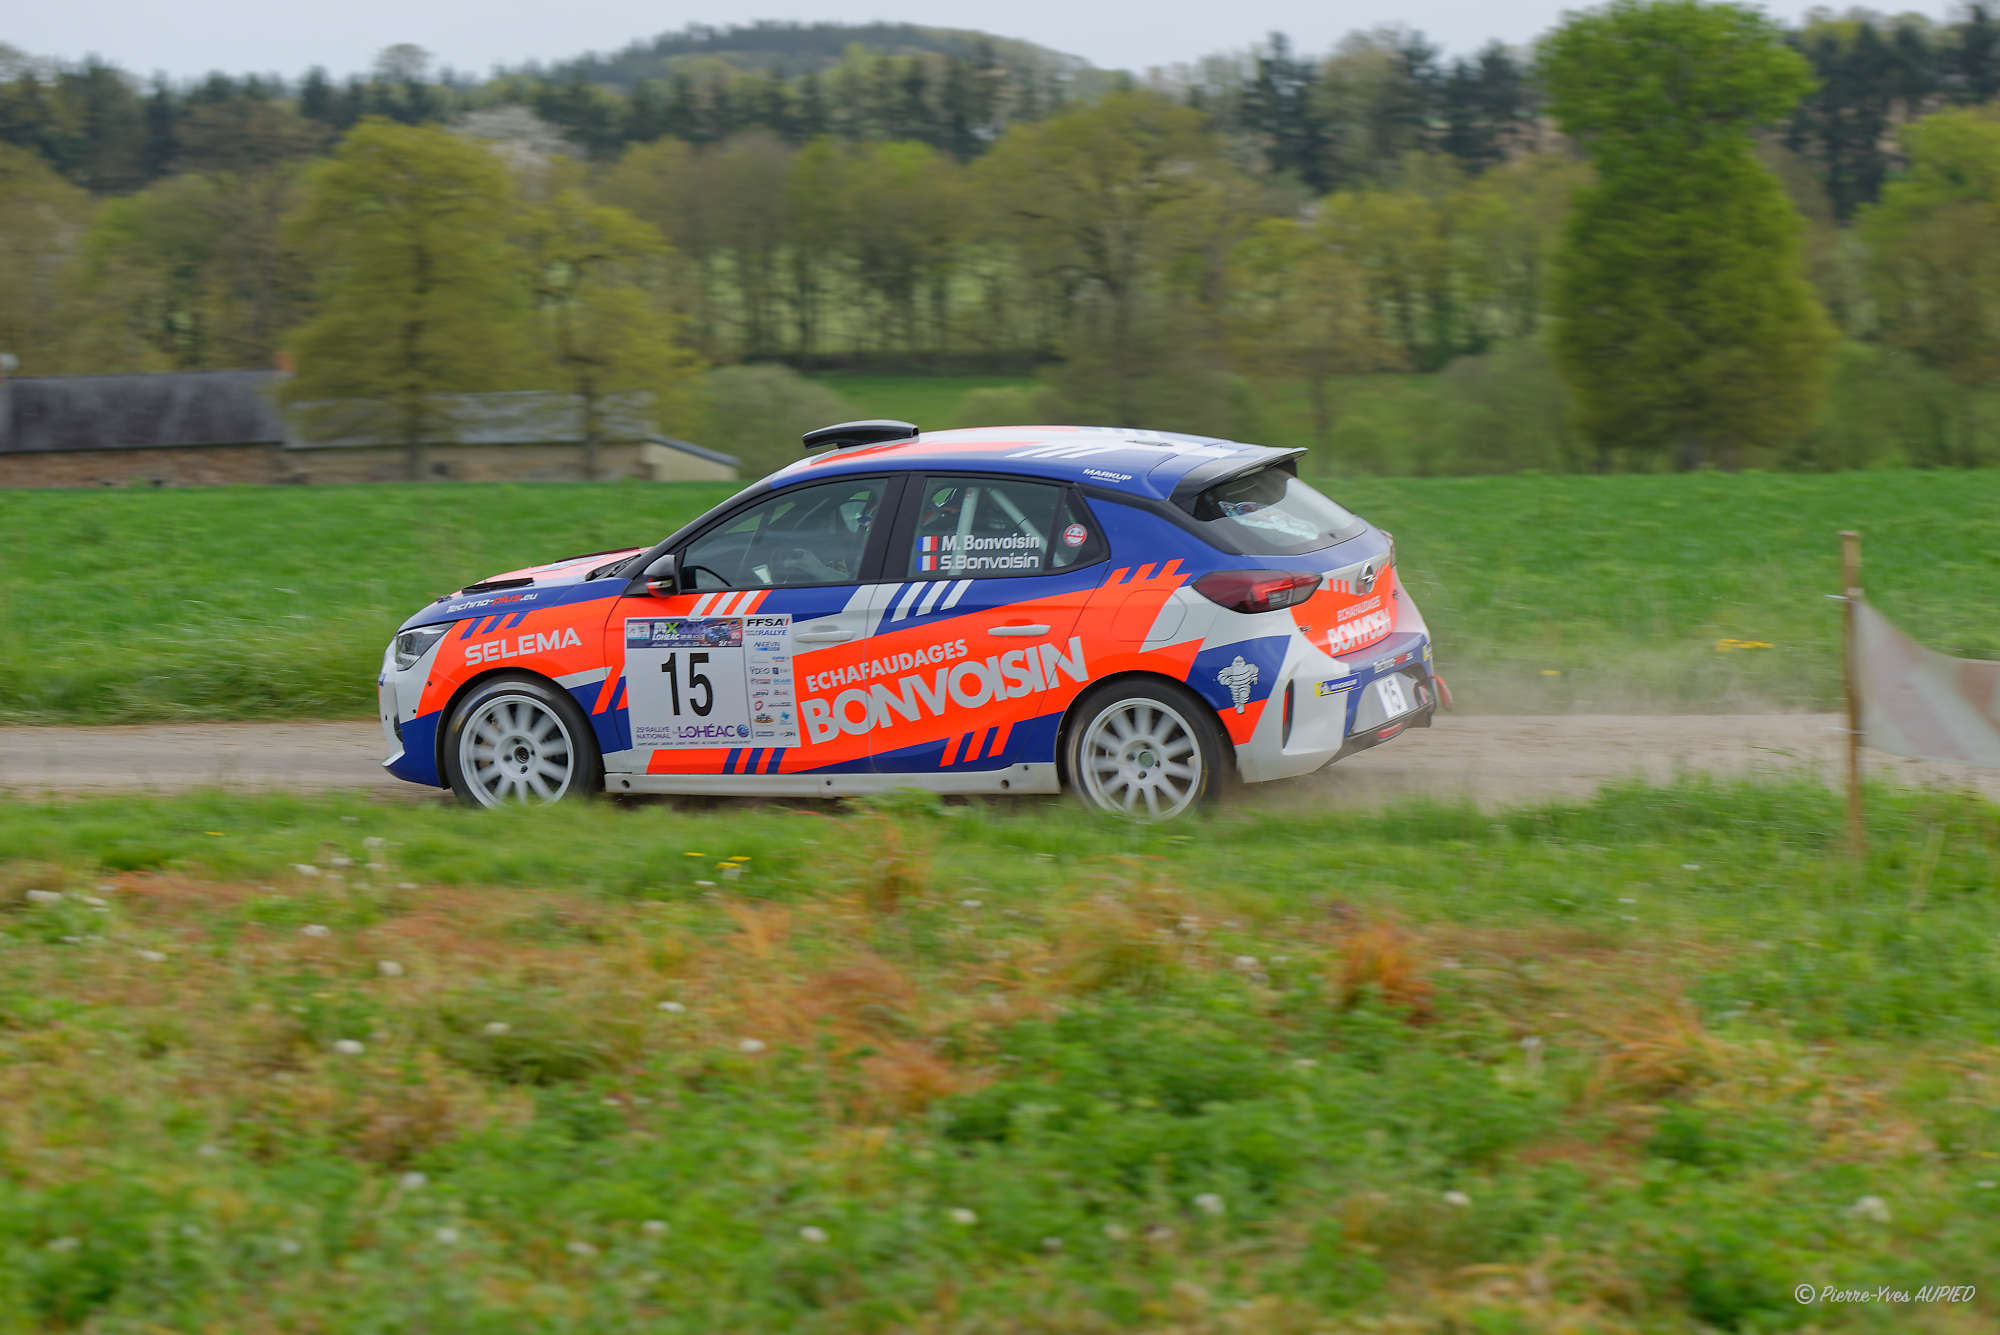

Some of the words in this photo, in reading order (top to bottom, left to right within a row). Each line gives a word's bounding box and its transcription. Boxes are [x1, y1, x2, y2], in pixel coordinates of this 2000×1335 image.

[1082, 468, 1133, 482] MARKUP
[941, 535, 961, 551] M.
[963, 532, 1040, 550] Bonvoisin
[465, 627, 582, 666] SELEMA
[805, 639, 968, 692] ECHAFAUDAGES
[661, 652, 714, 717] 15
[799, 636, 1089, 744] BONVOISIN
[677, 723, 735, 739] LOHÉAC
